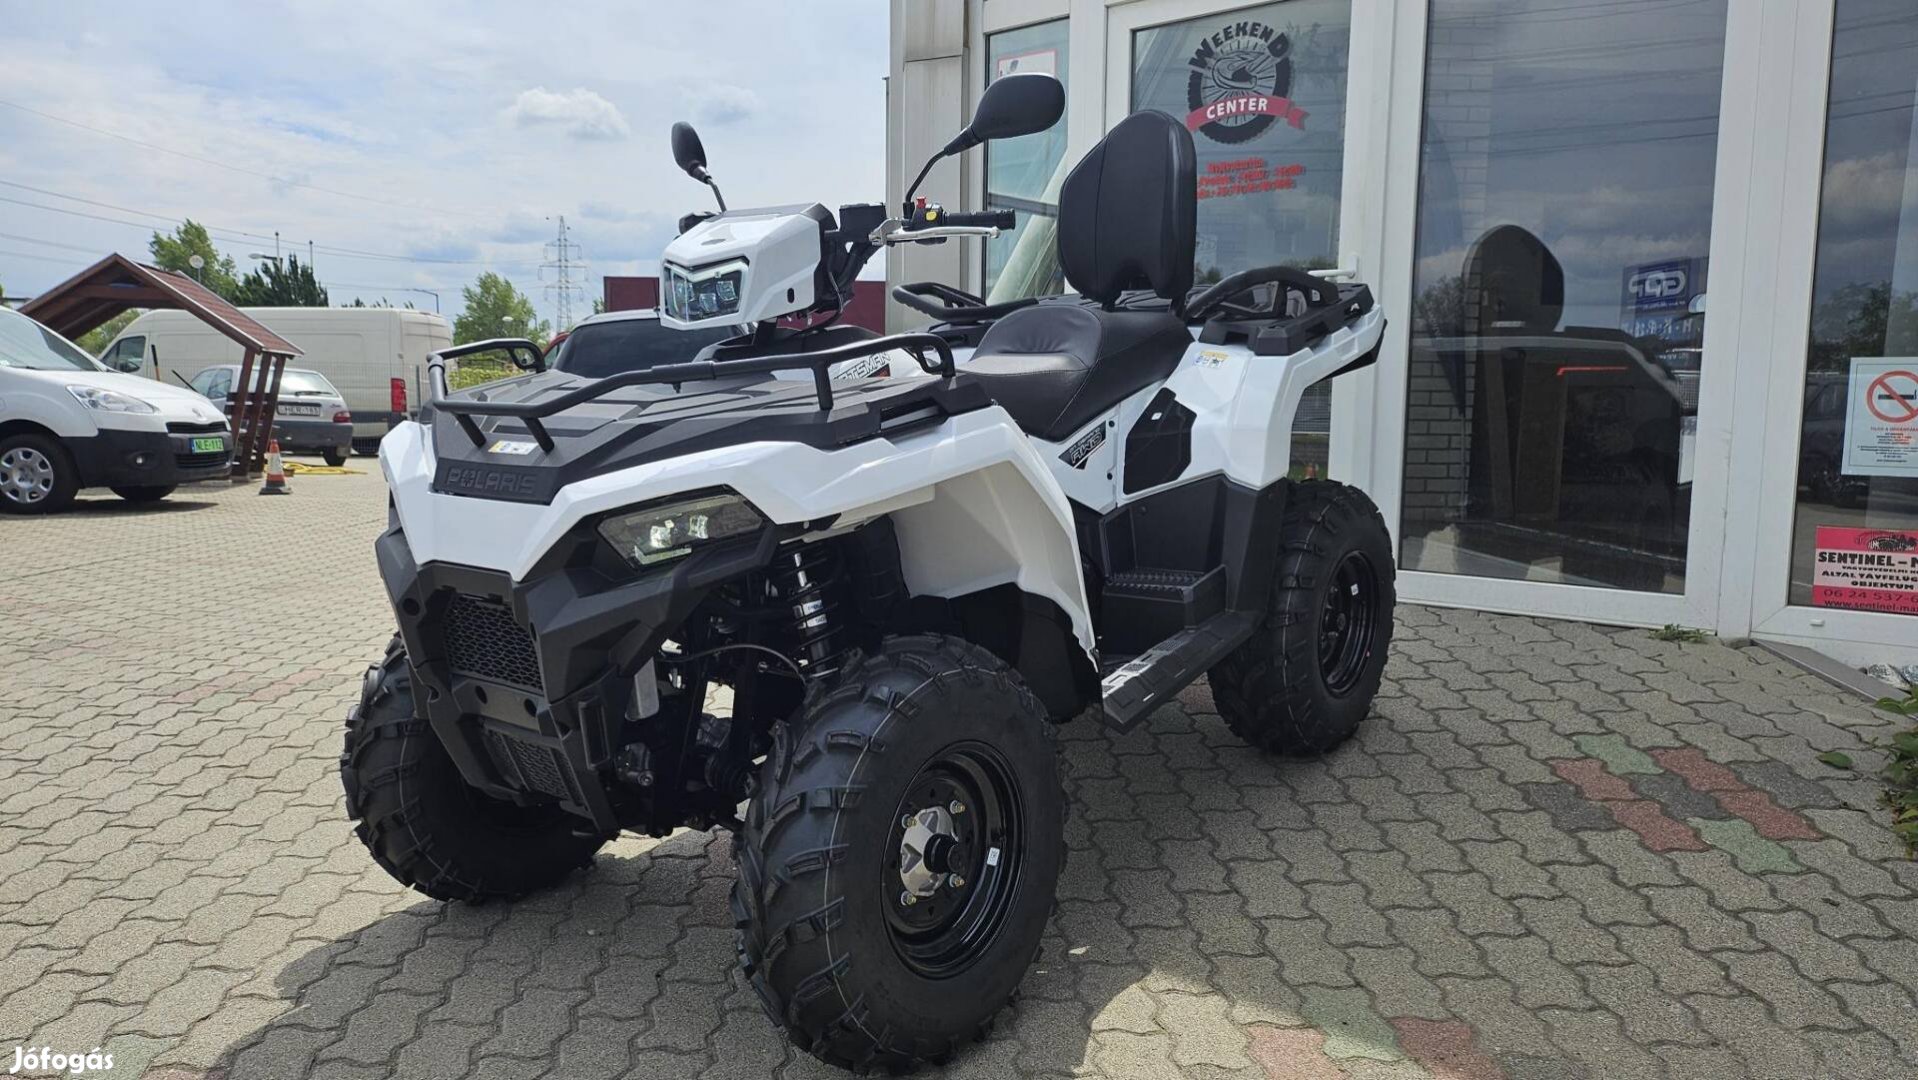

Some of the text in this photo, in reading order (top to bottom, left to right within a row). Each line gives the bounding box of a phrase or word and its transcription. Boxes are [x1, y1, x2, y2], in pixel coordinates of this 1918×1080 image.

[1188, 21, 1289, 69] WEEKEND
[1206, 97, 1268, 120] CENTER
[446, 466, 538, 494] POLARIS
[1818, 552, 1895, 566] SENTINEL
[1824, 588, 1842, 598] 06
[1849, 591, 1867, 599] 24
[1851, 581, 1914, 590] OBJEKTUM
